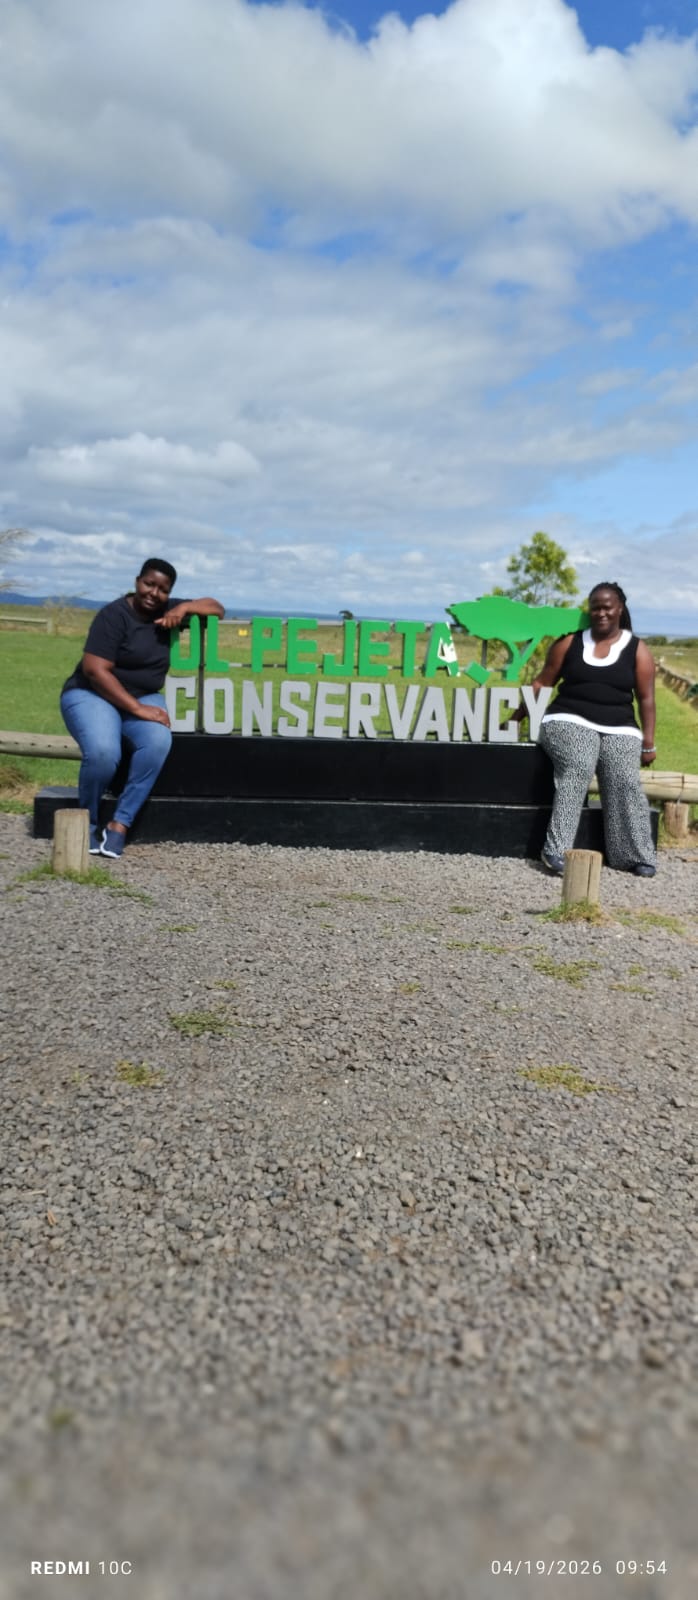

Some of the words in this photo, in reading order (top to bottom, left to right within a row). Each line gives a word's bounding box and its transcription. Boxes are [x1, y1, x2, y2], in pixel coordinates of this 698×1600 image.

[170, 615, 229, 673] OL
[251, 616, 461, 677] PEJETA
[166, 677, 553, 742] CONSERVANCY
